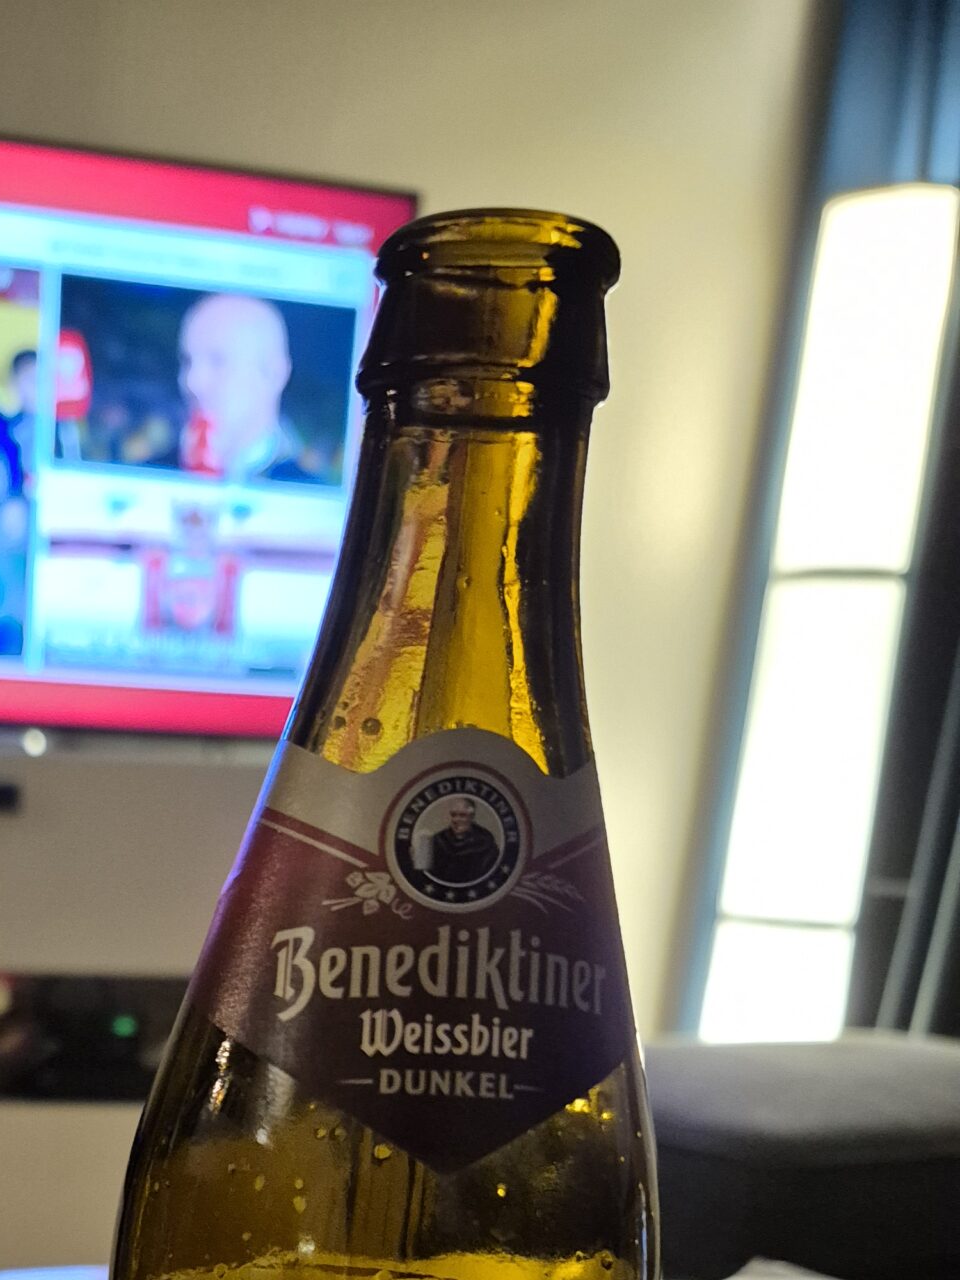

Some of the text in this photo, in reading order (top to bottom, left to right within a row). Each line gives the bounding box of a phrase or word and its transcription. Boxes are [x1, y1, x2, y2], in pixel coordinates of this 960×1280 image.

[397, 779, 518, 843] BENEDIKTINER
[270, 925, 606, 1022] Benediktiner
[359, 1008, 534, 1060] Weissbier
[378, 1067, 515, 1100] DUNKEL
